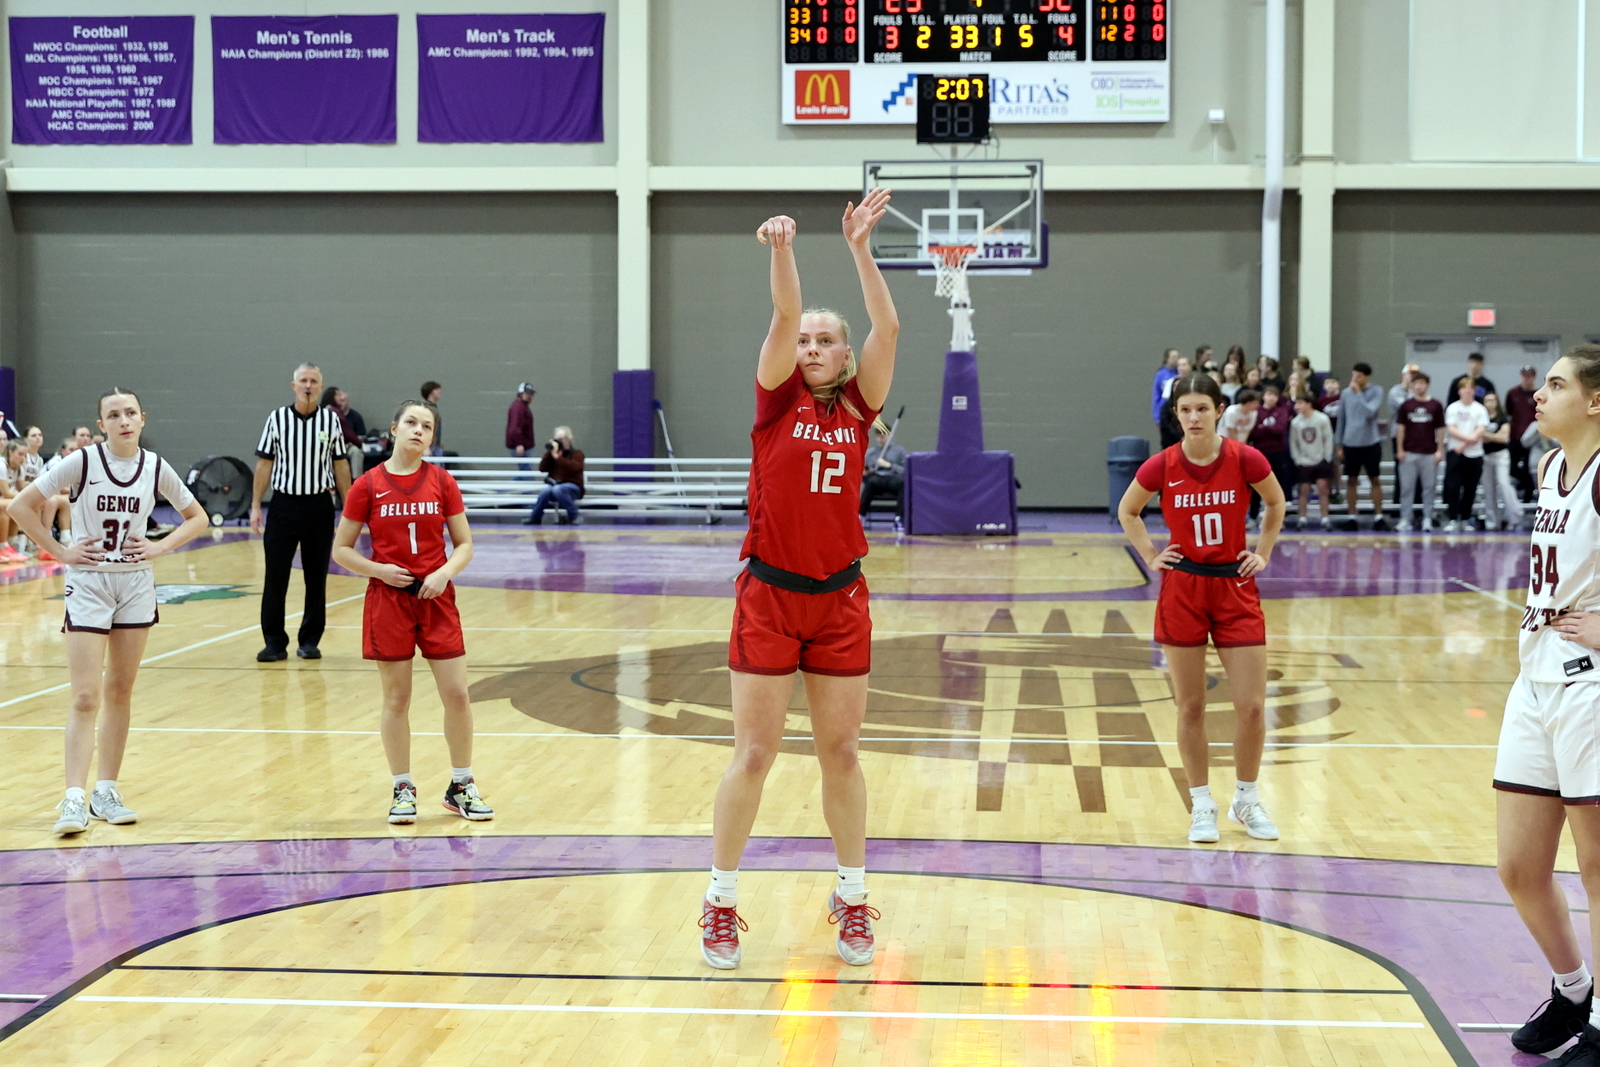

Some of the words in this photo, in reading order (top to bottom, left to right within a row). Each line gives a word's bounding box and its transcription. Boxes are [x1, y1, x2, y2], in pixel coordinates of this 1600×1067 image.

[790, 8, 811, 24] 33
[822, 8, 828, 23] 1
[844, 6, 856, 24] 0
[874, 14, 902, 26] FOULS
[944, 14, 978, 25] PLAYER
[982, 14, 1006, 24] FOUL
[1048, 13, 1078, 24] FOULS
[1101, 6, 1118, 20] 11
[1124, 4, 1136, 22] 0
[1152, 4, 1164, 22] 0
[73, 26, 128, 38] Football
[256, 30, 300, 45] Men's
[303, 30, 352, 44] Tennis
[466, 28, 510, 44] Men's
[514, 28, 556, 43] Track
[790, 27, 811, 44] 34
[816, 26, 828, 44] 0
[844, 26, 856, 44] 0
[886, 26, 898, 49] 3
[916, 26, 931, 49] 2
[950, 25, 979, 48] 33
[994, 26, 1002, 46] 1
[1018, 24, 1034, 48] 5
[1058, 26, 1073, 46] 4
[1101, 24, 1118, 42] 12
[1124, 24, 1135, 42] 2
[1152, 24, 1164, 42] 0
[33, 42, 62, 52] NWOC
[64, 42, 118, 53] Champions:
[122, 42, 146, 52] 1932,
[221, 48, 246, 59] NAIA
[247, 48, 302, 61] Champions
[304, 48, 343, 61] (District
[427, 46, 452, 58] AMC
[452, 46, 512, 60] Champions:
[25, 53, 46, 63] MOL
[47, 53, 100, 64] Champions:
[874, 52, 903, 63] SCORE
[1047, 50, 1078, 62] SCORE
[38, 76, 60, 86] MOC
[62, 76, 115, 87] Champions:
[76, 87, 129, 98] Champions:
[134, 86, 154, 96] 1972
[936, 78, 984, 100] 2:07
[25, 99, 48, 108] NAIA
[49, 98, 86, 108] National
[87, 98, 126, 110] Playoffs:
[796, 106, 819, 114] Lewis
[820, 106, 848, 116] Family
[998, 105, 1068, 116] PARTNERS
[51, 110, 73, 119] AMC
[74, 110, 128, 121] Champions:
[47, 122, 74, 130] HCAC
[76, 121, 128, 132] Champions:
[133, 121, 154, 130] 2000
[810, 450, 846, 494] 12
[1174, 490, 1236, 508] BELLEVUE
[380, 502, 440, 517] BELLEVUE
[1191, 512, 1224, 548] 10
[408, 522, 418, 554] 1
[1532, 543, 1560, 598] 34
